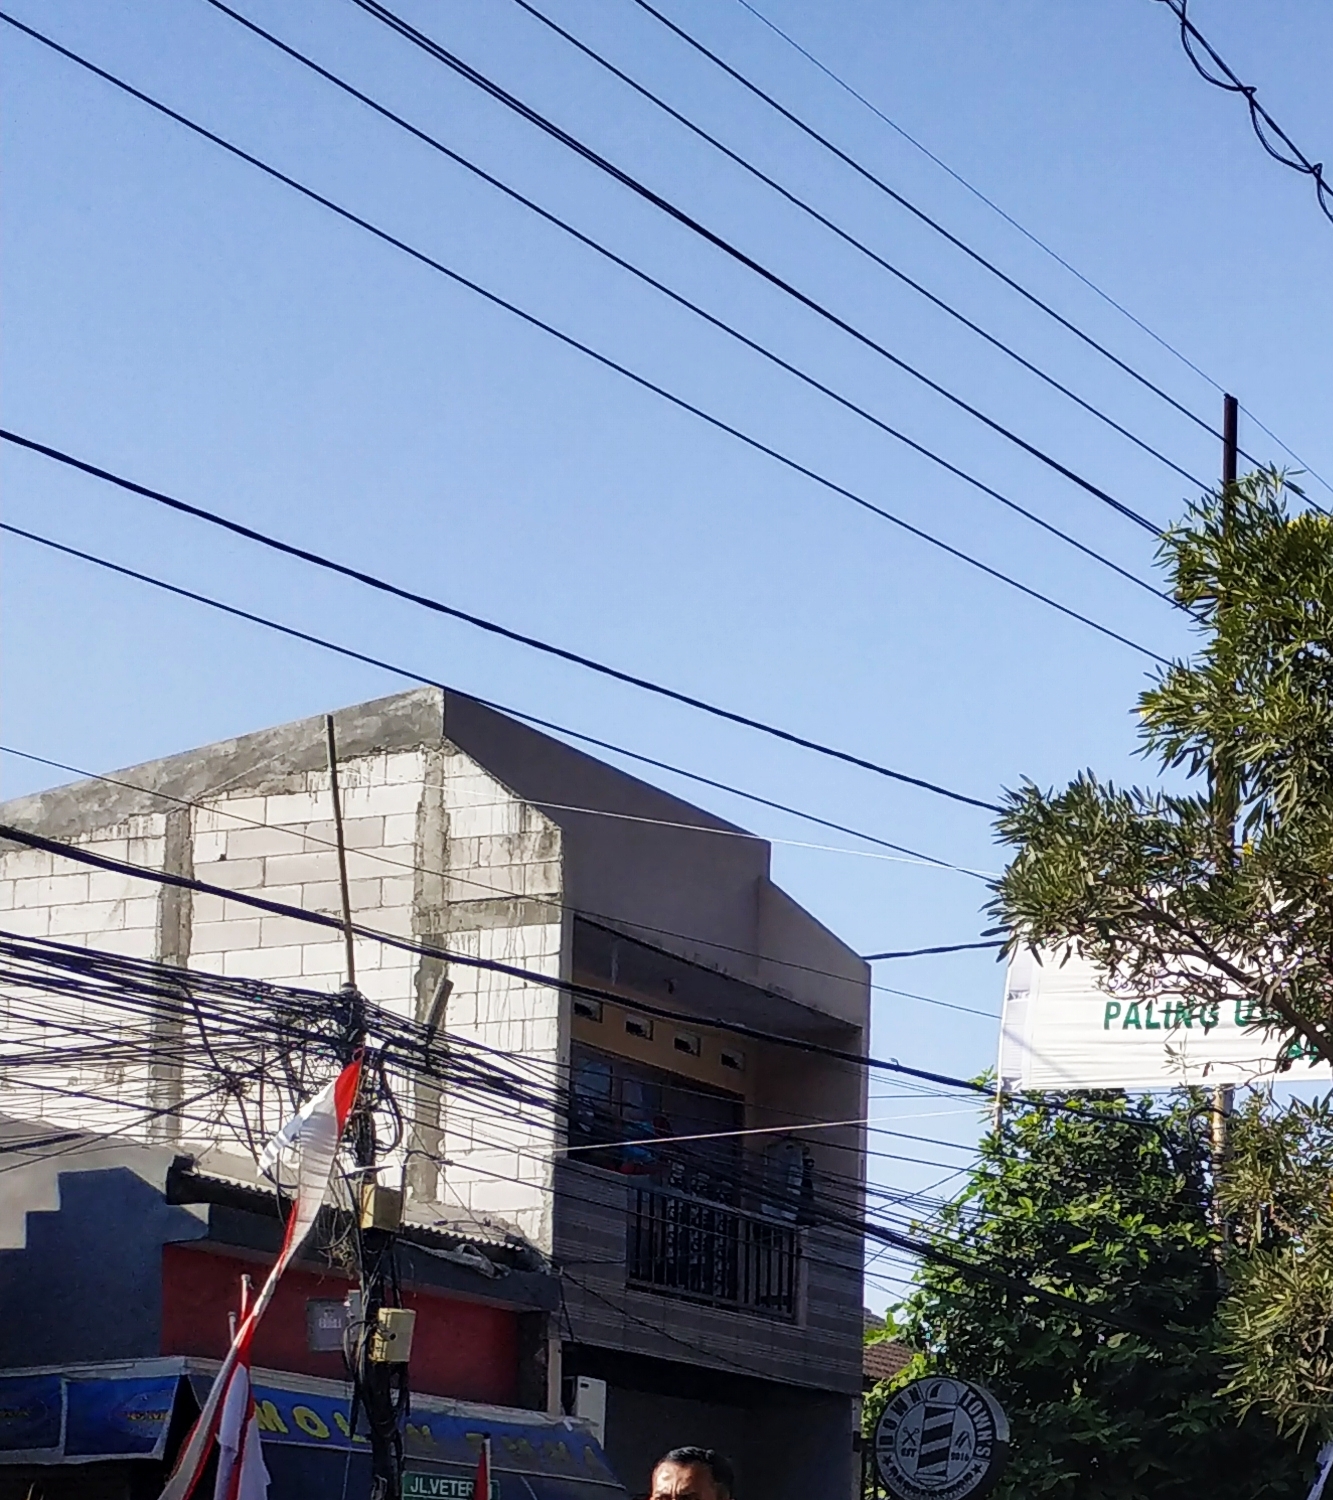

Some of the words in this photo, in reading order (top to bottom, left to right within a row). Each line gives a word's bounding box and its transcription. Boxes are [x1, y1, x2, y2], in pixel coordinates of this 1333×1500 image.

[1104, 999, 1219, 1030] PALING
[879, 1387, 920, 1446] DOWN
[410, 1477, 493, 1499] JL.VETER
